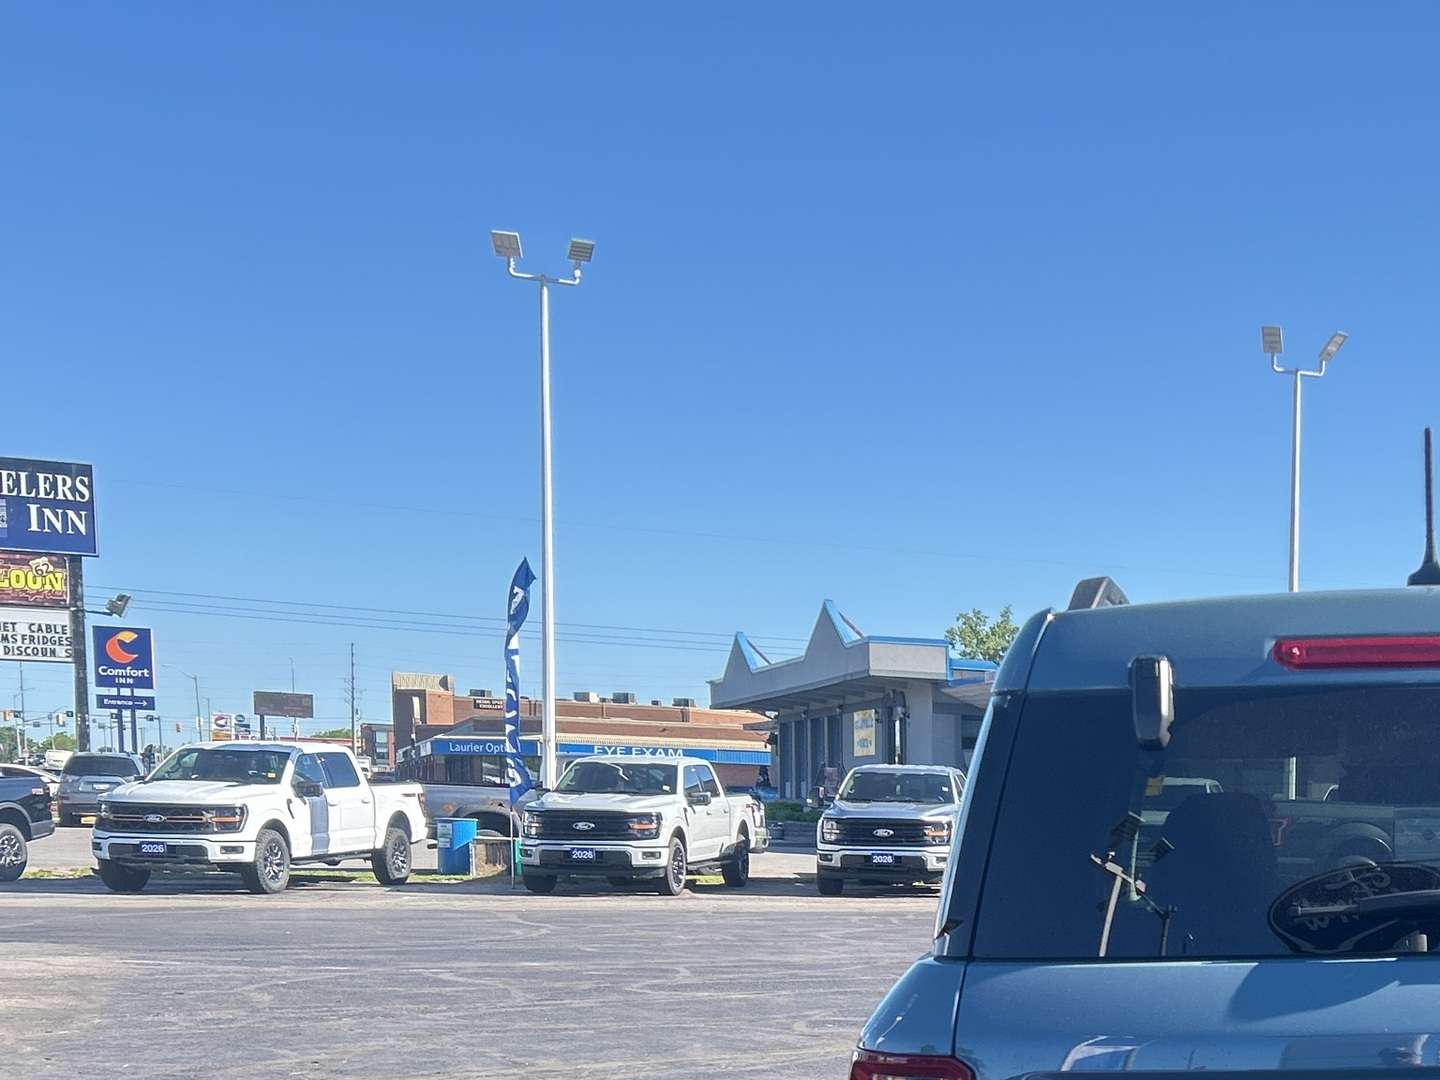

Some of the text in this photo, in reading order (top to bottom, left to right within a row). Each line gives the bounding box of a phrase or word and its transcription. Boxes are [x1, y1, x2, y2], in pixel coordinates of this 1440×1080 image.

[0, 470, 90, 502] ELERS
[26, 503, 88, 536] INN
[0, 622, 68, 635] ET CABLE
[21, 634, 73, 647] FRIDGES
[98, 666, 150, 678] Comfort
[115, 677, 134, 685] INN
[103, 698, 134, 706] Entrance
[449, 742, 483, 752] Laurier
[141, 844, 165, 854] 2026
